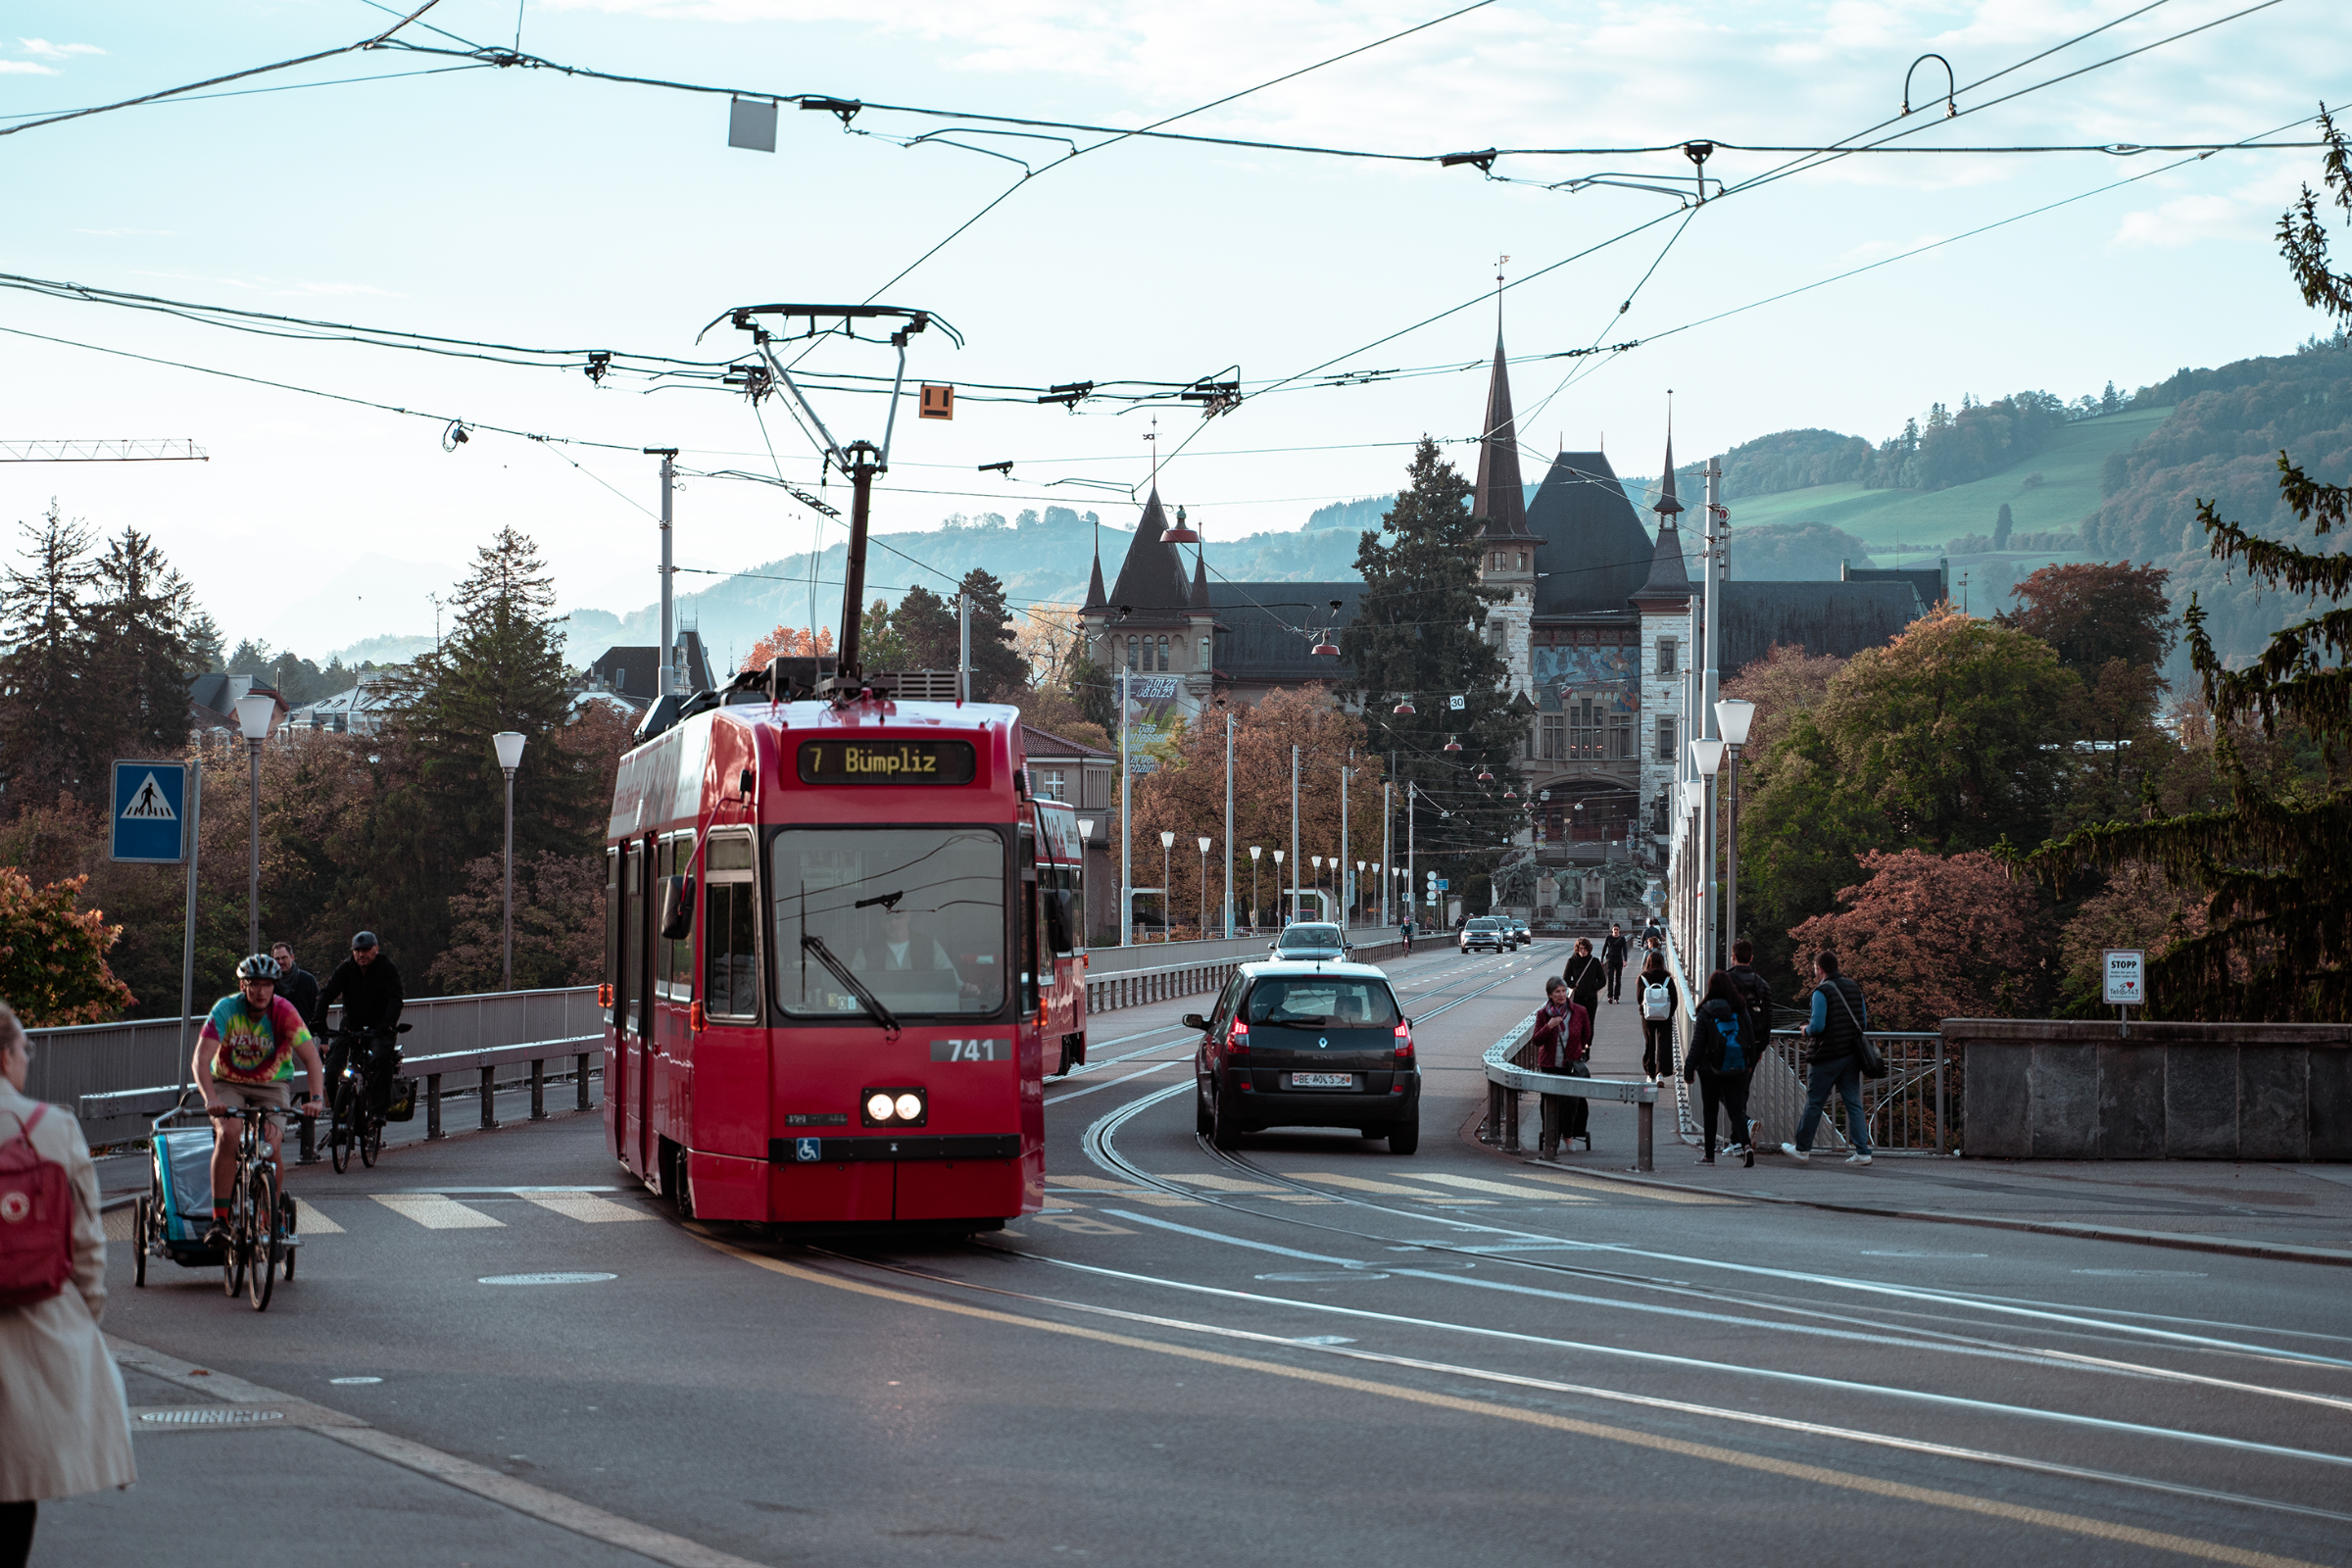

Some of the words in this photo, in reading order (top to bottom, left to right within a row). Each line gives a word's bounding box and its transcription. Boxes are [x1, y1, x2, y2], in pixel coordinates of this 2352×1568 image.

[1451, 698, 1464, 707] 30
[1130, 743, 1146, 752] eld
[809, 748, 822, 772] 7
[846, 747, 937, 775] Bümpliz
[229, 1035, 274, 1049] NEVADA
[949, 1039, 994, 1062] 741
